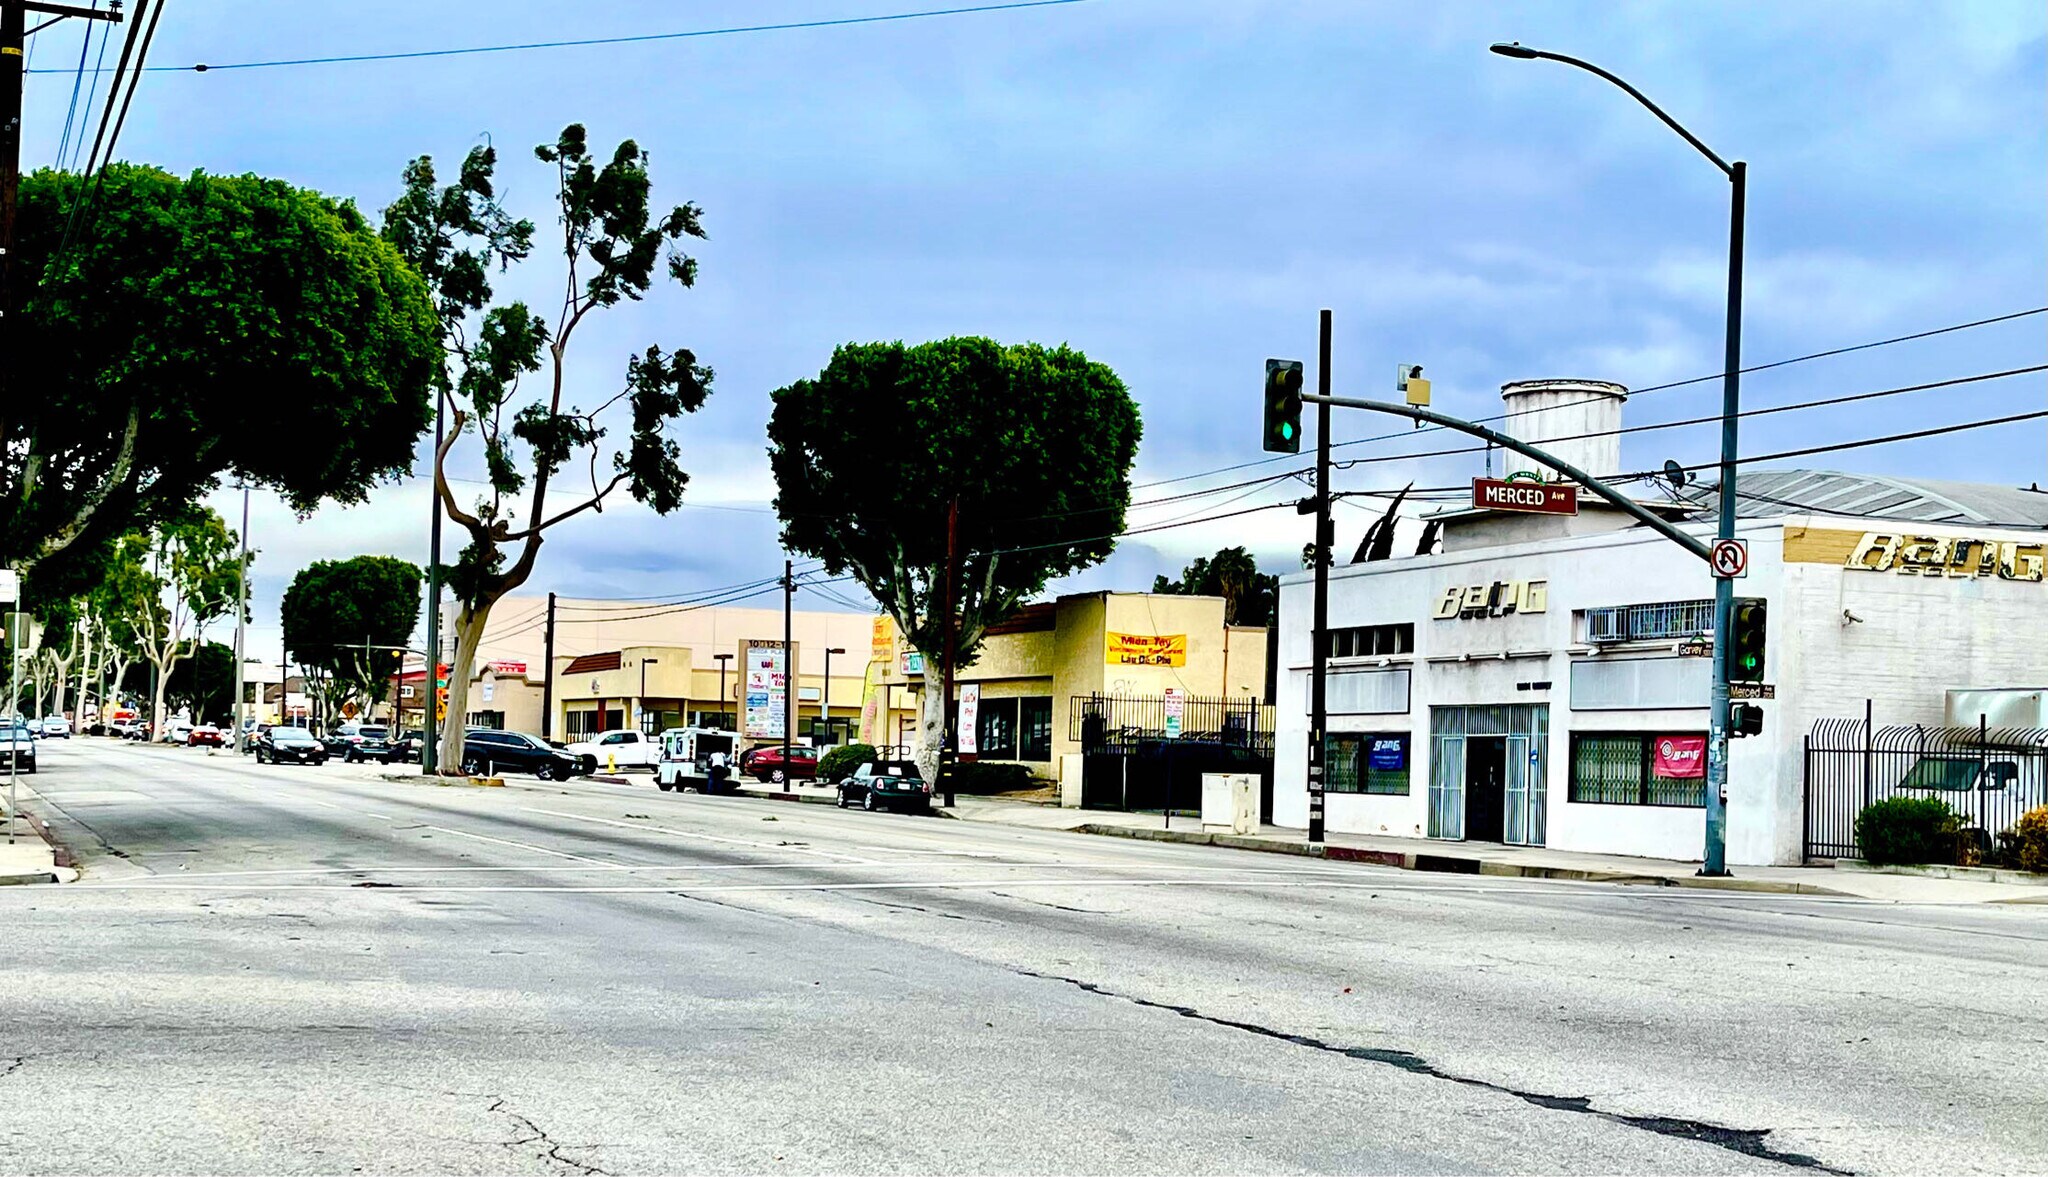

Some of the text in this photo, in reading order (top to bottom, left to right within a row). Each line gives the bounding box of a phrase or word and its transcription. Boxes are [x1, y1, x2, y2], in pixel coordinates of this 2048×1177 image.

[1486, 486, 1566, 506] MERCED Ave
[1680, 644, 1703, 656] Garvey
[1730, 685, 1761, 698] Merced
